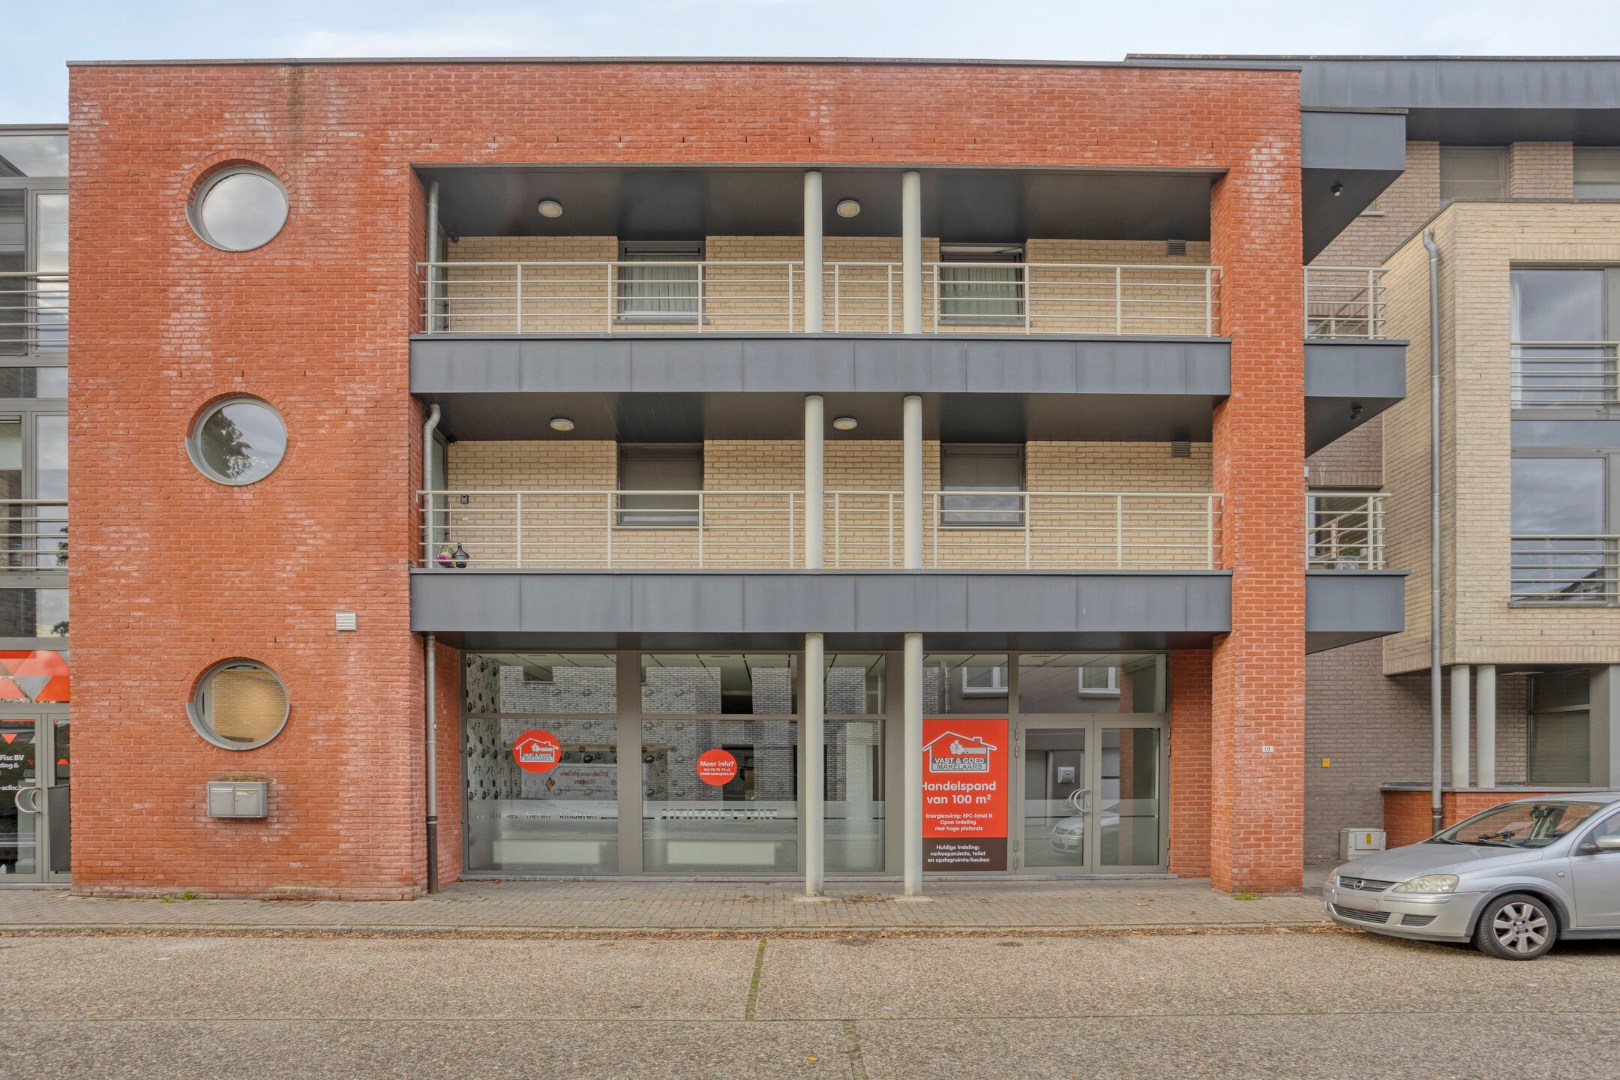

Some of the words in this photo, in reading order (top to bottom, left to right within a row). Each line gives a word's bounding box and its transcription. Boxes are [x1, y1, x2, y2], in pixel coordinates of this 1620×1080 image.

[922, 781, 997, 793] Handelspand
[926, 796, 948, 804] van
[952, 795, 972, 804] 100
